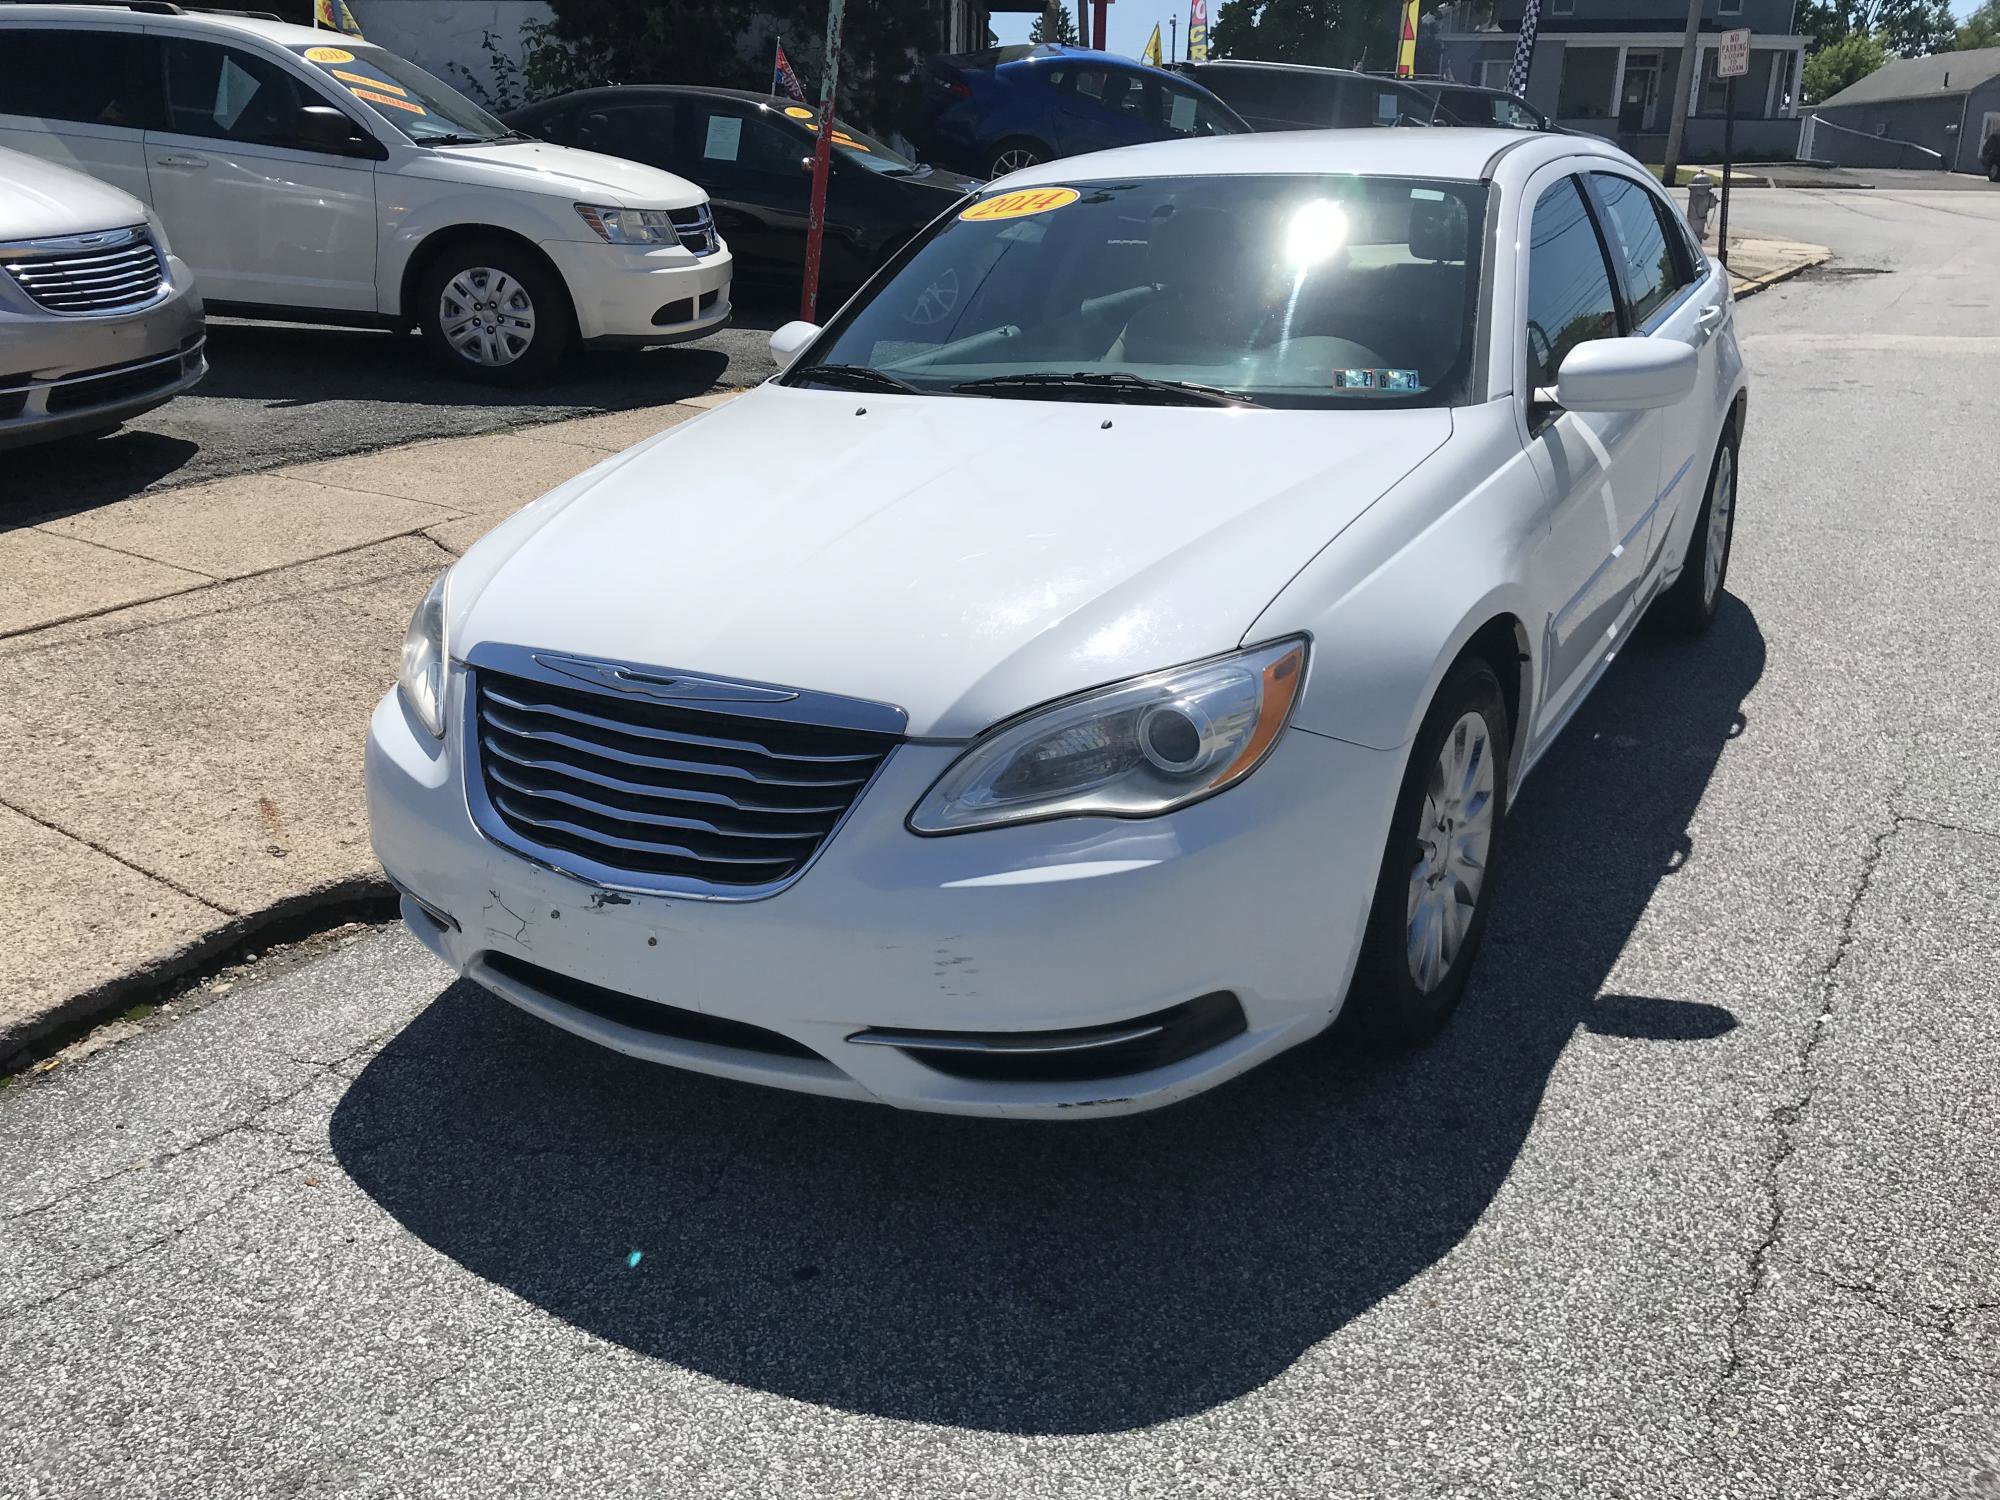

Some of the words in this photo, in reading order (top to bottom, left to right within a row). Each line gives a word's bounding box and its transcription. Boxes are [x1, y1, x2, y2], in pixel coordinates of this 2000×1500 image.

[1730, 33, 1740, 43] NO
[1721, 42, 1747, 53] PARKING
[972, 191, 1065, 217] 2014
